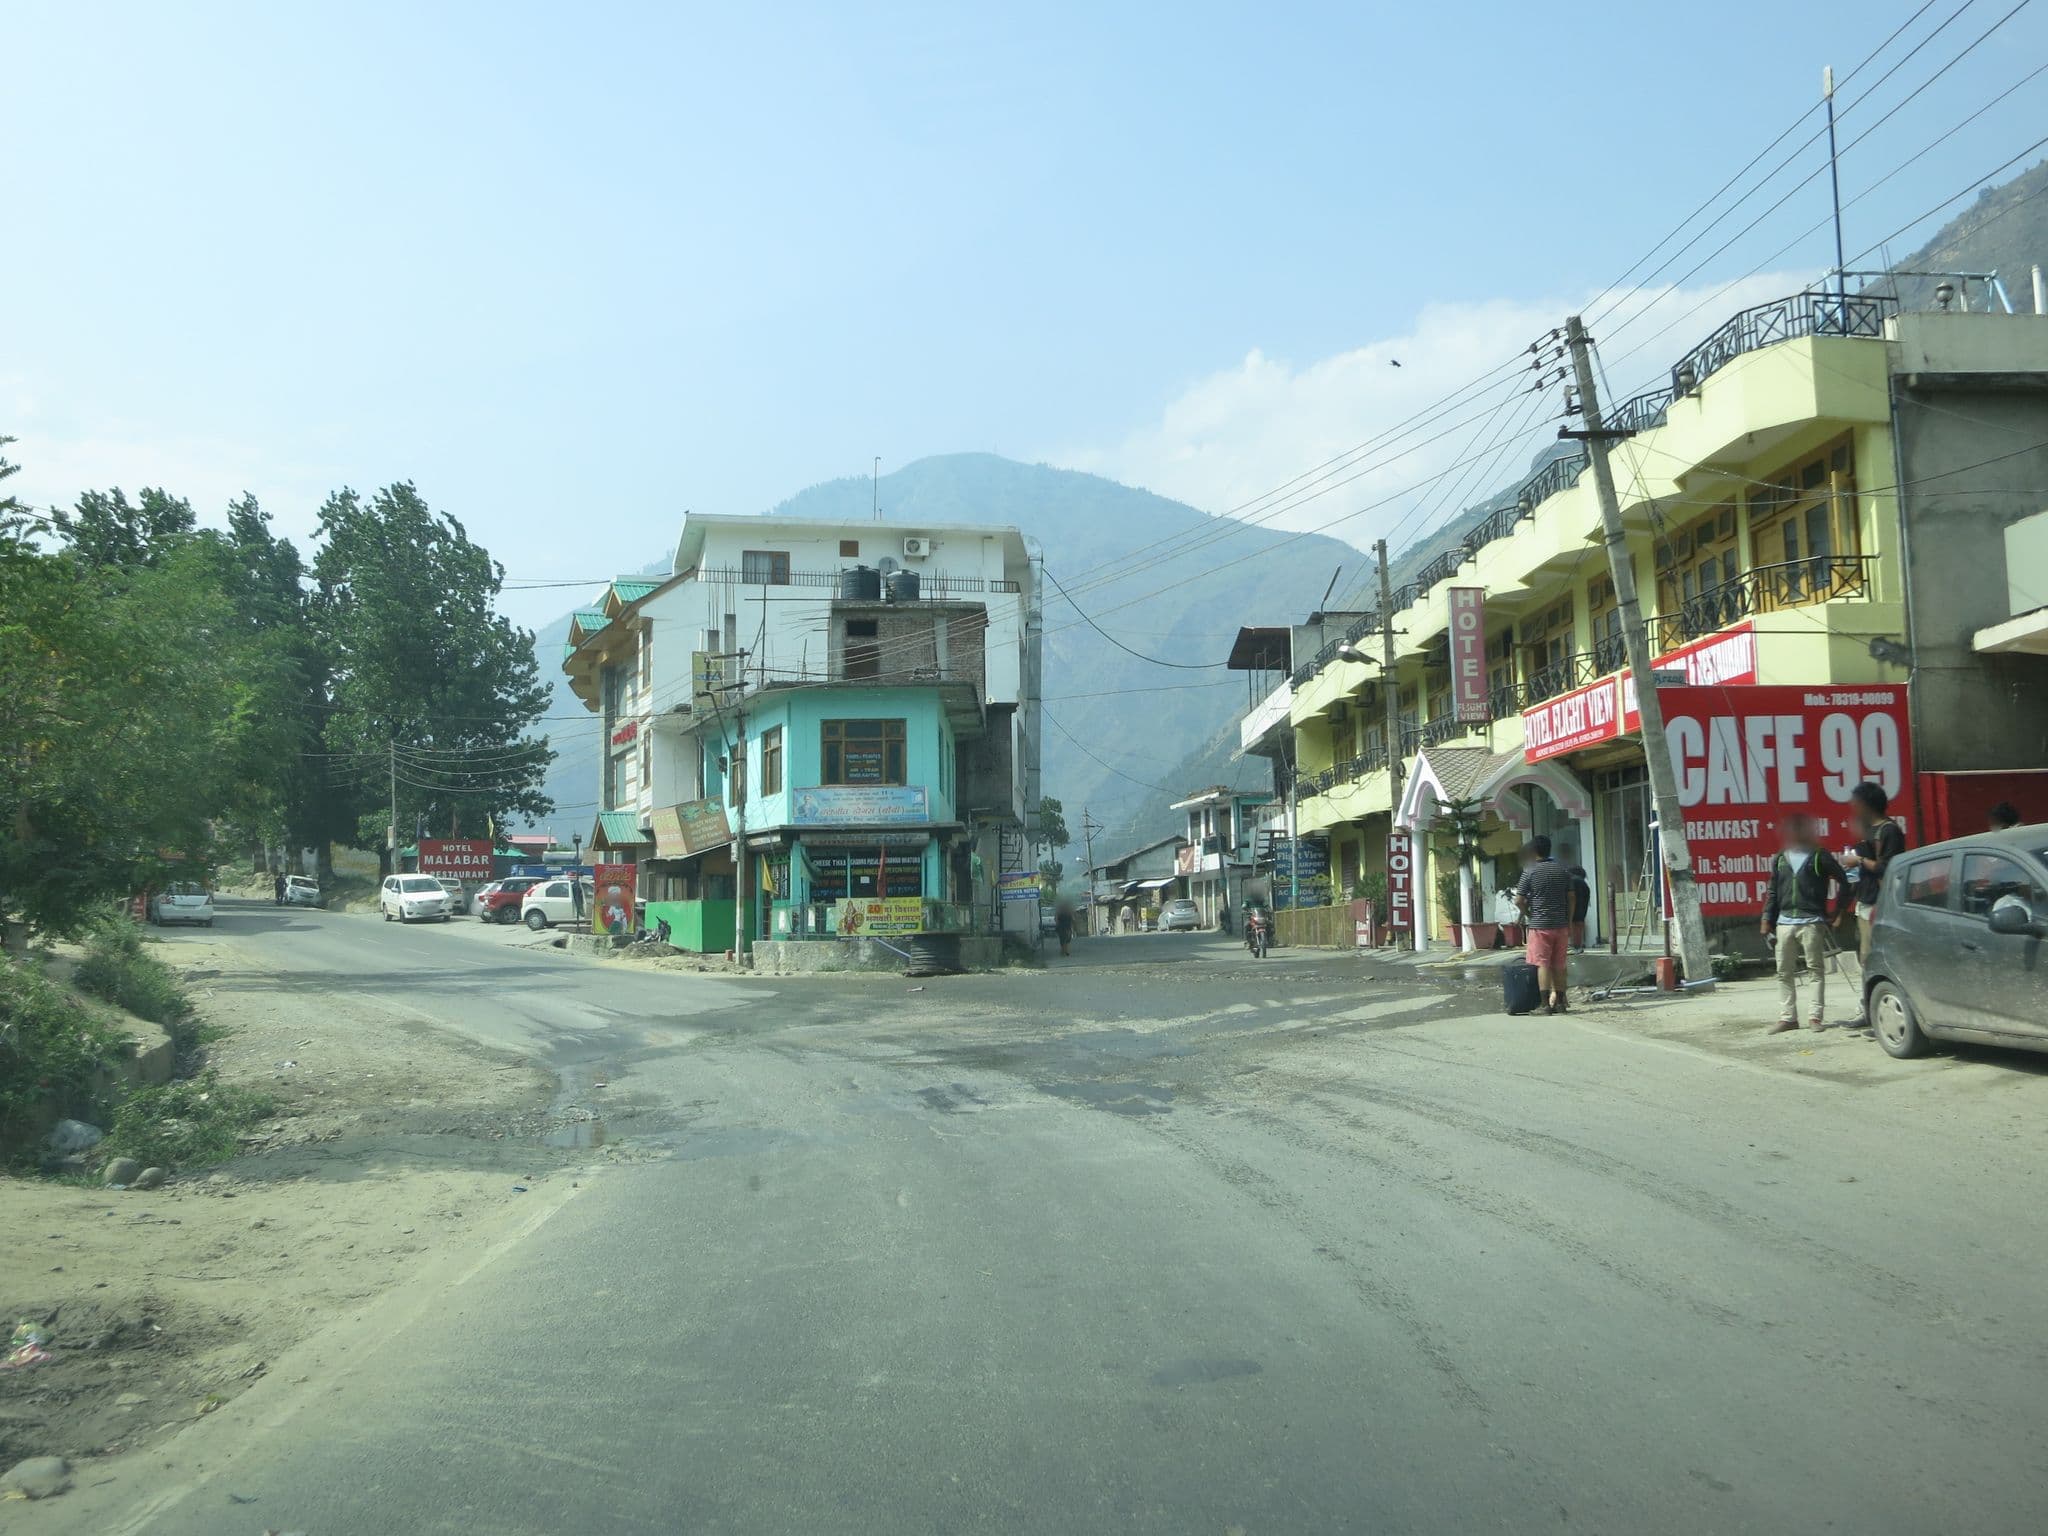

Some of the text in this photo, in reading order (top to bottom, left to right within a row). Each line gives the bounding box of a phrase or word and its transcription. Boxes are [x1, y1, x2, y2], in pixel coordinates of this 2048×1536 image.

[1457, 590, 1480, 699] HOTEL
[1457, 702, 1487, 712] FLIGHT
[1460, 712, 1486, 720] VIEW
[1523, 708, 1553, 750] HOTEL
[1552, 693, 1586, 740] FLIGHT
[1586, 682, 1614, 727] VIEW
[1665, 711, 1901, 807] CAFE 99
[1686, 820, 1760, 841] REAKFAST
[442, 844, 473, 852] HOTEL
[1276, 841, 1304, 850] HOTL
[424, 855, 489, 865] MALABAR
[1719, 855, 1754, 874] South
[1756, 854, 1776, 873] Ind
[1390, 836, 1408, 926] HOTEL
[867, 904, 881, 914] 20
